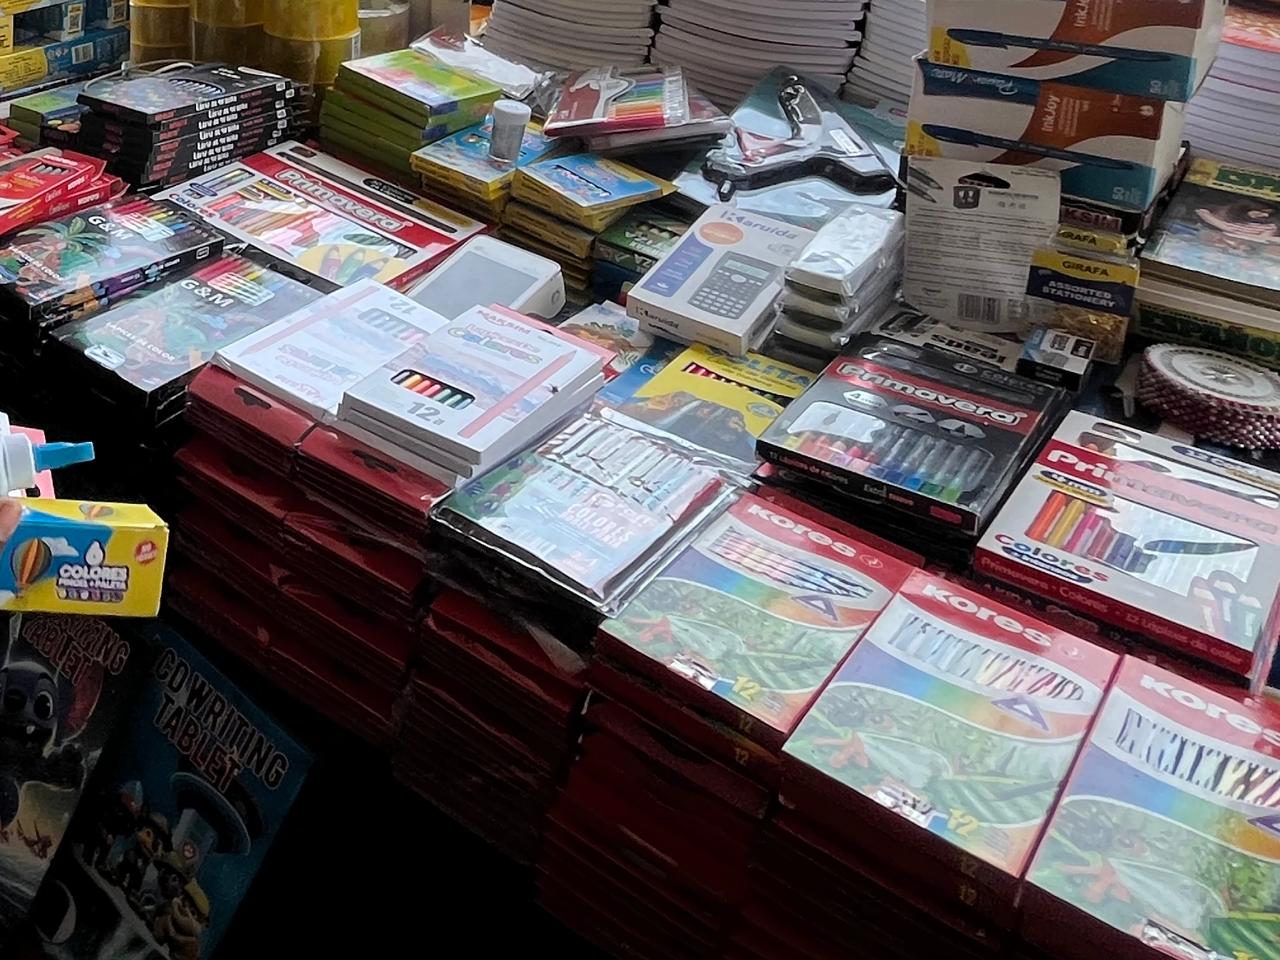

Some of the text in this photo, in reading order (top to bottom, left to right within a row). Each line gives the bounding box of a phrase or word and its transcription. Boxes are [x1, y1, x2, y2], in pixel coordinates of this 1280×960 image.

[1042, 94, 1061, 133] InkJoy
[169, 193, 217, 219] Colores
[274, 167, 413, 232] Primavera
[88, 215, 133, 240] G&M
[1062, 260, 1110, 277] GIRAFA
[180, 279, 235, 308] G&M
[1042, 286, 1116, 308] STATIONERY
[1048, 281, 1112, 300] ASSORTED
[838, 362, 1022, 425] Primavera
[1046, 449, 1280, 535] Primavera
[994, 533, 1110, 583] Colores
[734, 674, 761, 701] 12
[153, 690, 245, 794] TABLET
[185, 672, 291, 792] WRITING
[947, 806, 980, 836] 12
